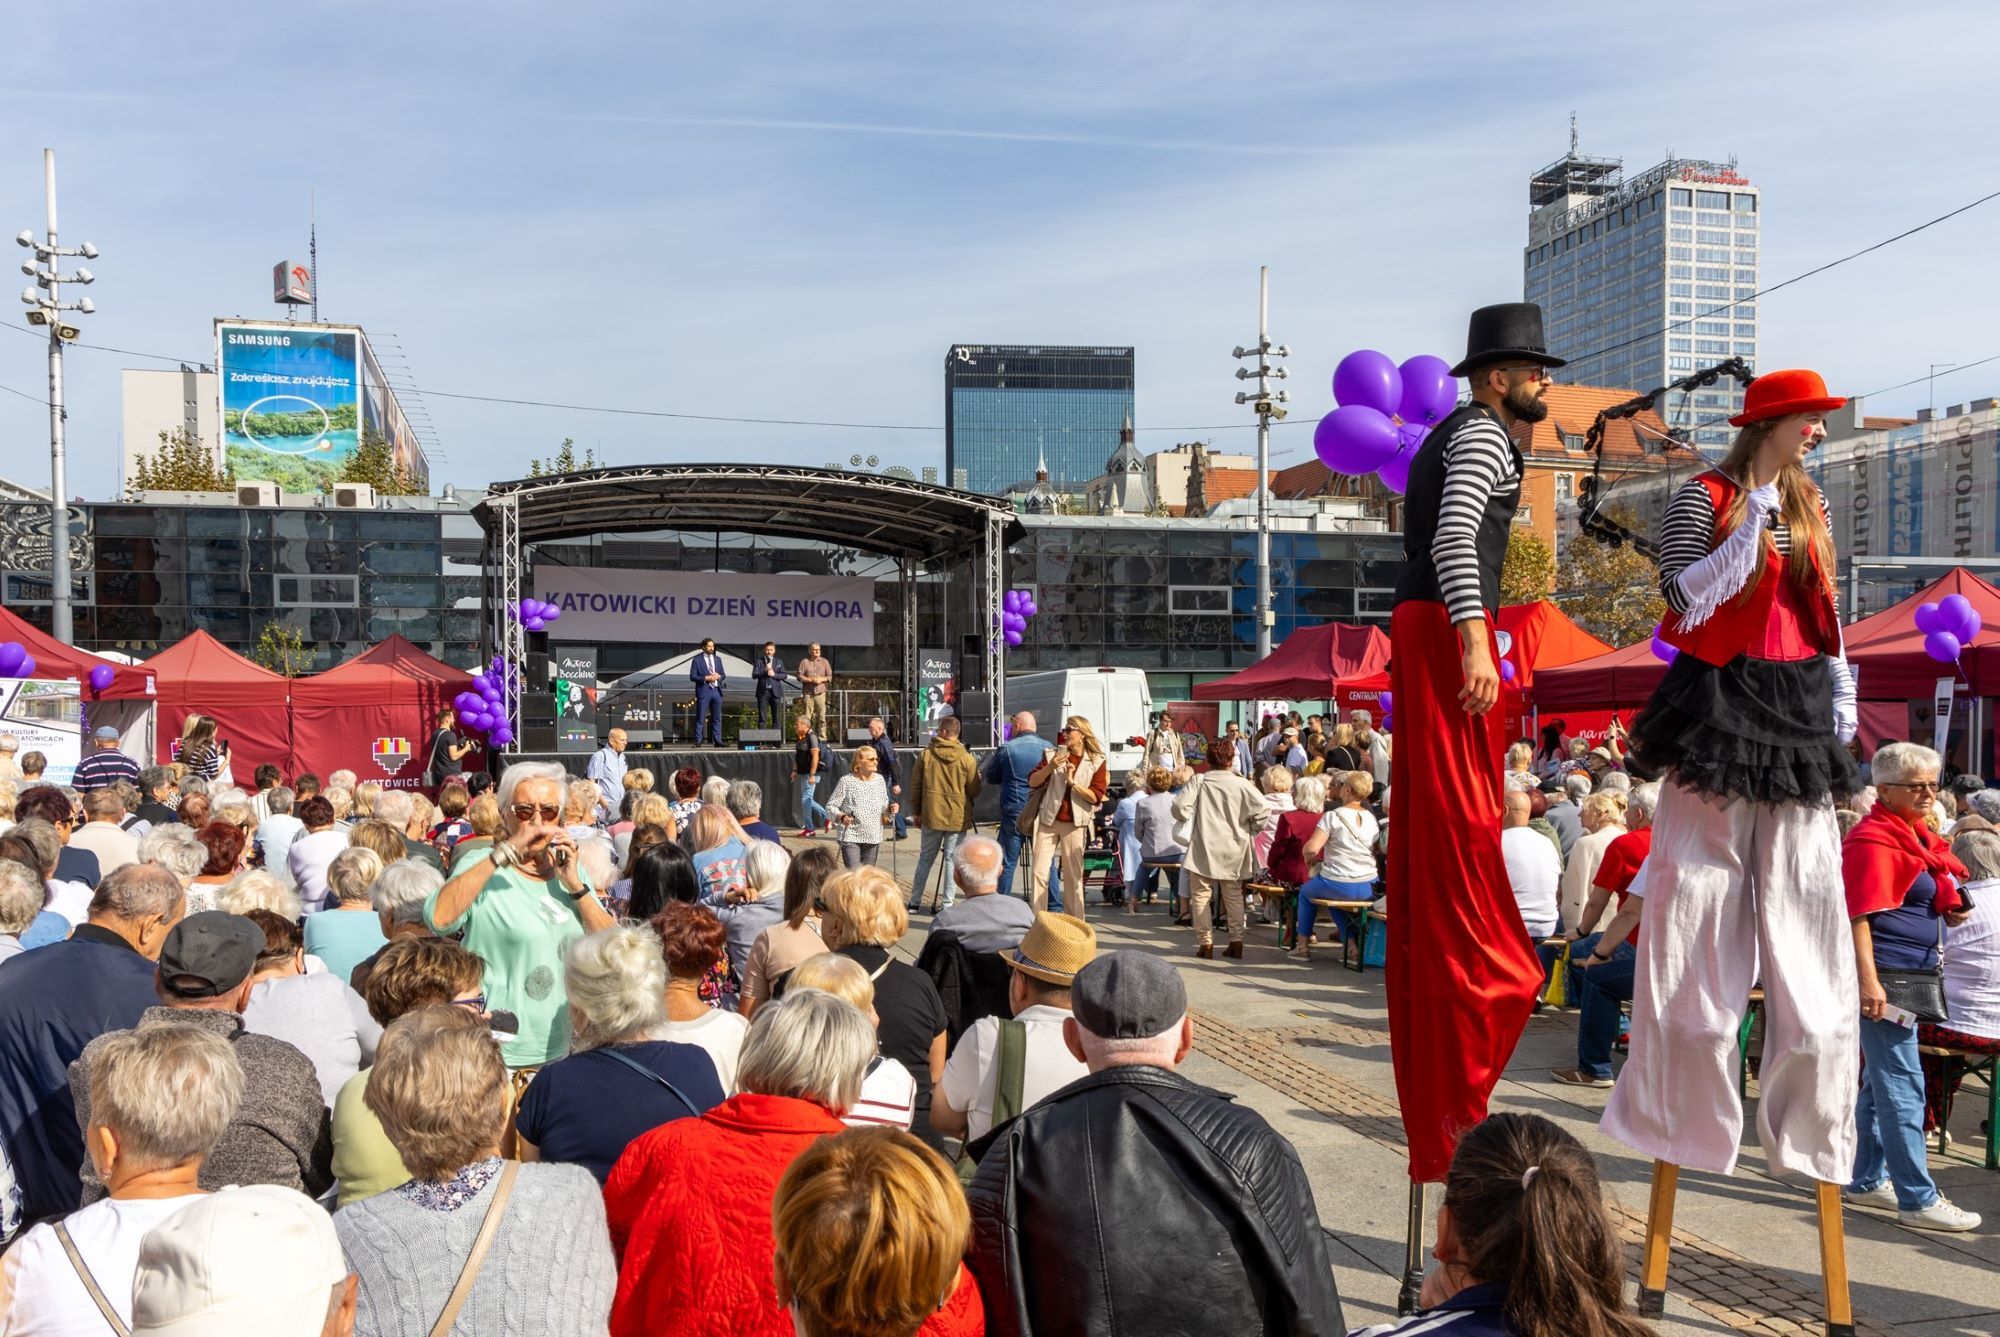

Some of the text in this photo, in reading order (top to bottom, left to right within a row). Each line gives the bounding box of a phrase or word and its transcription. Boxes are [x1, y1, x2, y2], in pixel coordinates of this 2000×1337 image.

[228, 333, 291, 346] SAMSUNG
[230, 372, 350, 388] Zakreślasz, znajdujesz
[1853, 440, 1869, 556] OPTOLIT
[1954, 416, 1974, 557] OPTOLITH
[545, 592, 864, 619] KATOWICKI DZIEŃ SENIORA
